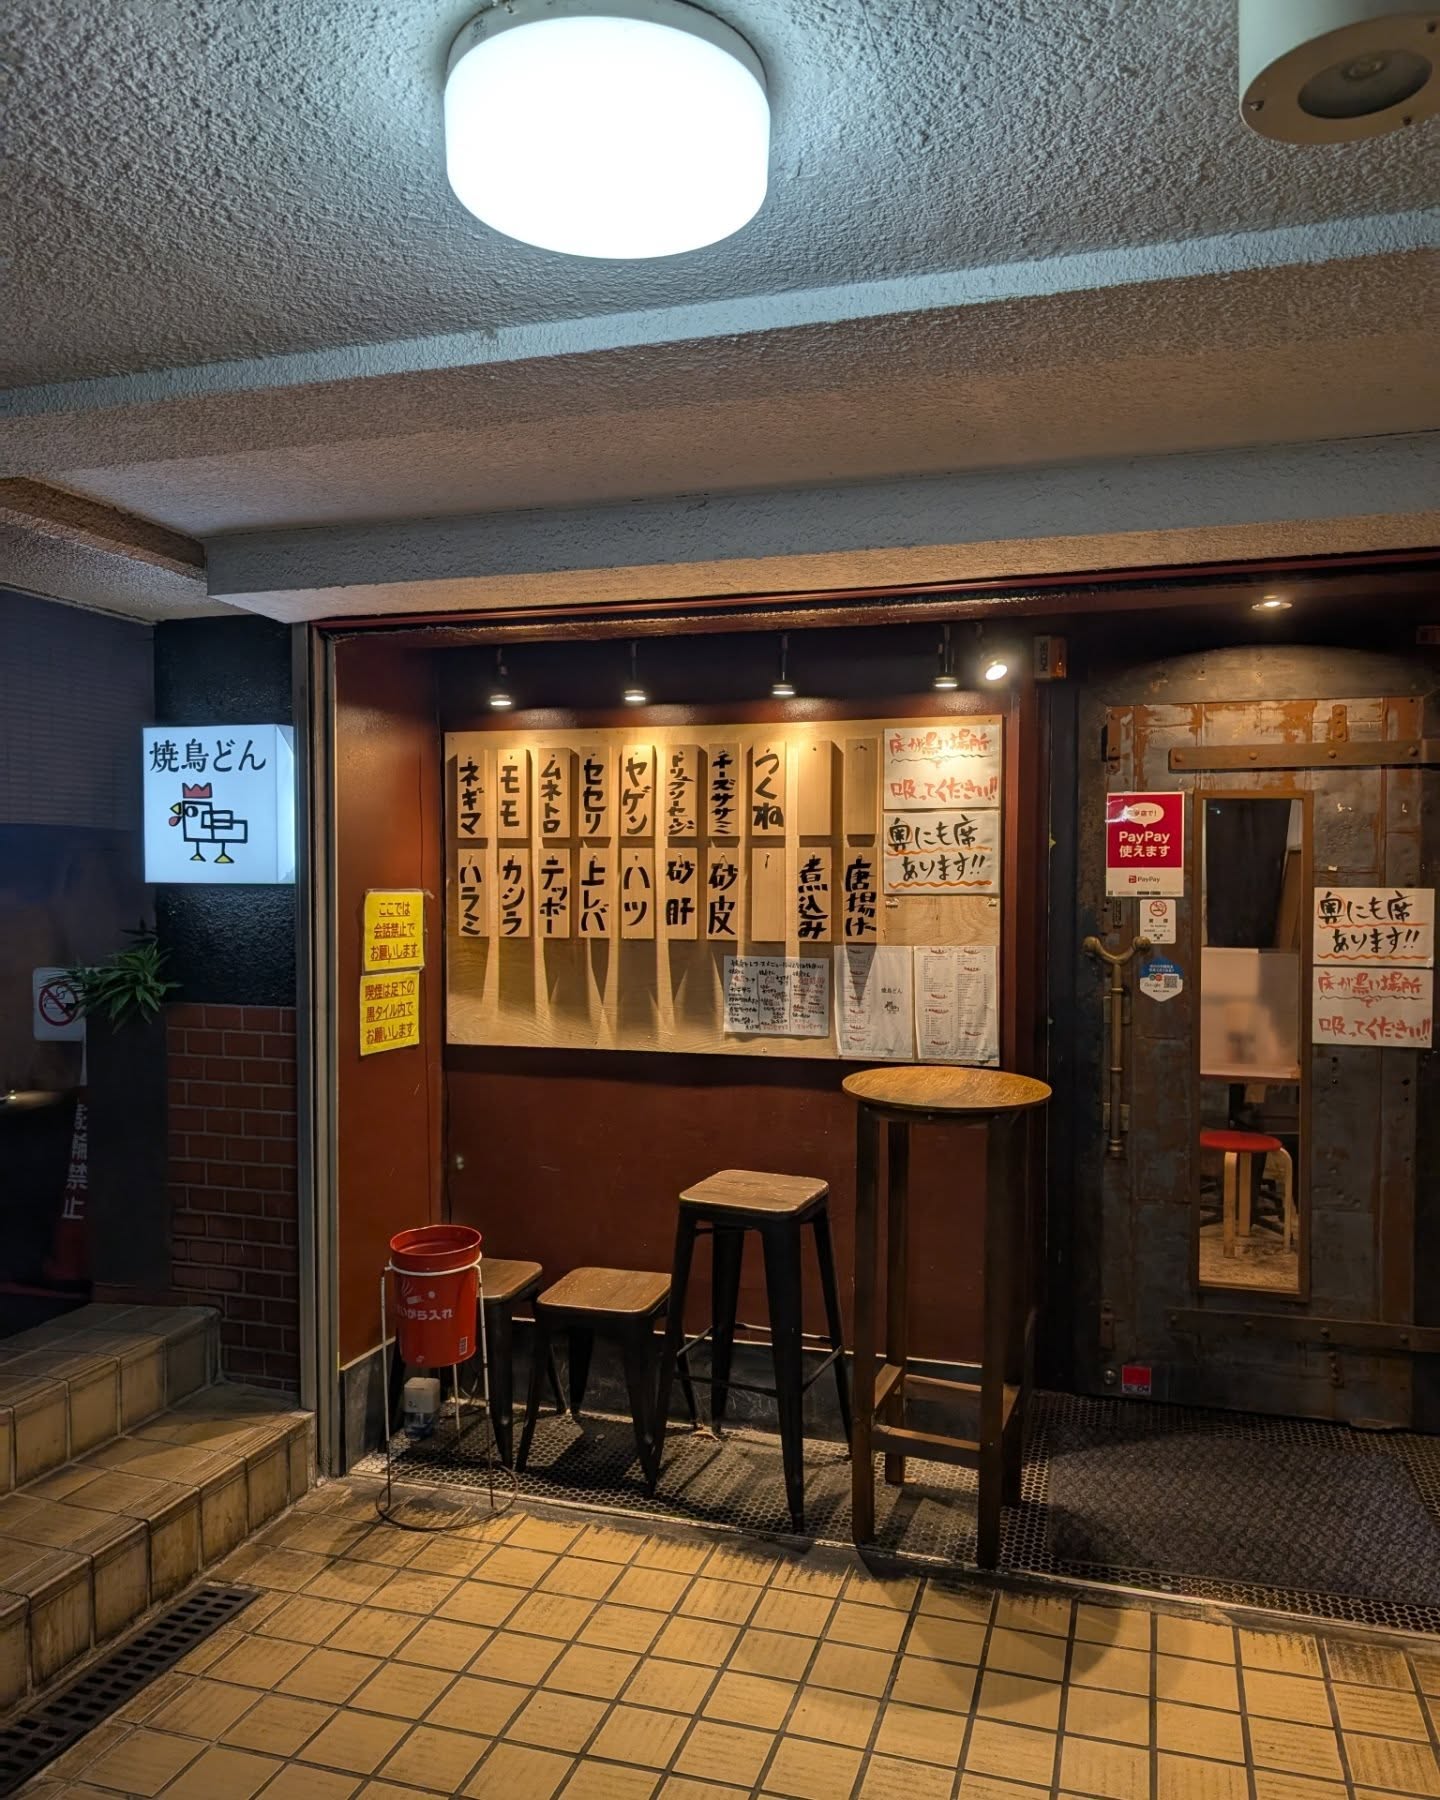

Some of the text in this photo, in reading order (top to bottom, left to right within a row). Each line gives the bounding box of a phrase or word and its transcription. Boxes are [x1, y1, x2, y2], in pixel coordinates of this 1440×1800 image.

[149, 738, 267, 773] 焼鳥どん
[459, 760, 484, 835] ネギマ
[500, 765, 520, 827] モモ
[540, 759, 562, 834] ムネトロ
[583, 758, 606, 835] セセリ
[622, 758, 651, 835] ヤゲン
[711, 752, 736, 834] チーズササミ
[753, 753, 784, 830] つくね
[889, 814, 979, 852] 奥にも席
[1119, 831, 1171, 844] PayPay
[1119, 845, 1171, 858] 使えます
[378, 902, 411, 916] ここでは
[460, 865, 482, 935] ハラミ
[502, 860, 525, 935] カシラ
[539, 859, 568, 934] テッポー
[581, 860, 609, 932] 上レバ
[623, 866, 651, 926] ハツ
[666, 860, 695, 926] 砂肝
[708, 861, 738, 936] 砂皮
[798, 857, 829, 939] 煮込み
[844, 857, 877, 937] 唐揚げ
[1137, 876, 1161, 884] PayPay
[1319, 890, 1415, 924] 奥にも席
[370, 944, 418, 961] お願いします
[374, 922, 416, 940] 会話禁止で
[365, 980, 415, 1000] 喫煙は足下の
[367, 1001, 414, 1022] 黒タイル内で
[1318, 971, 1422, 995] 床が黒い場所
[367, 1023, 414, 1045] お願いします
